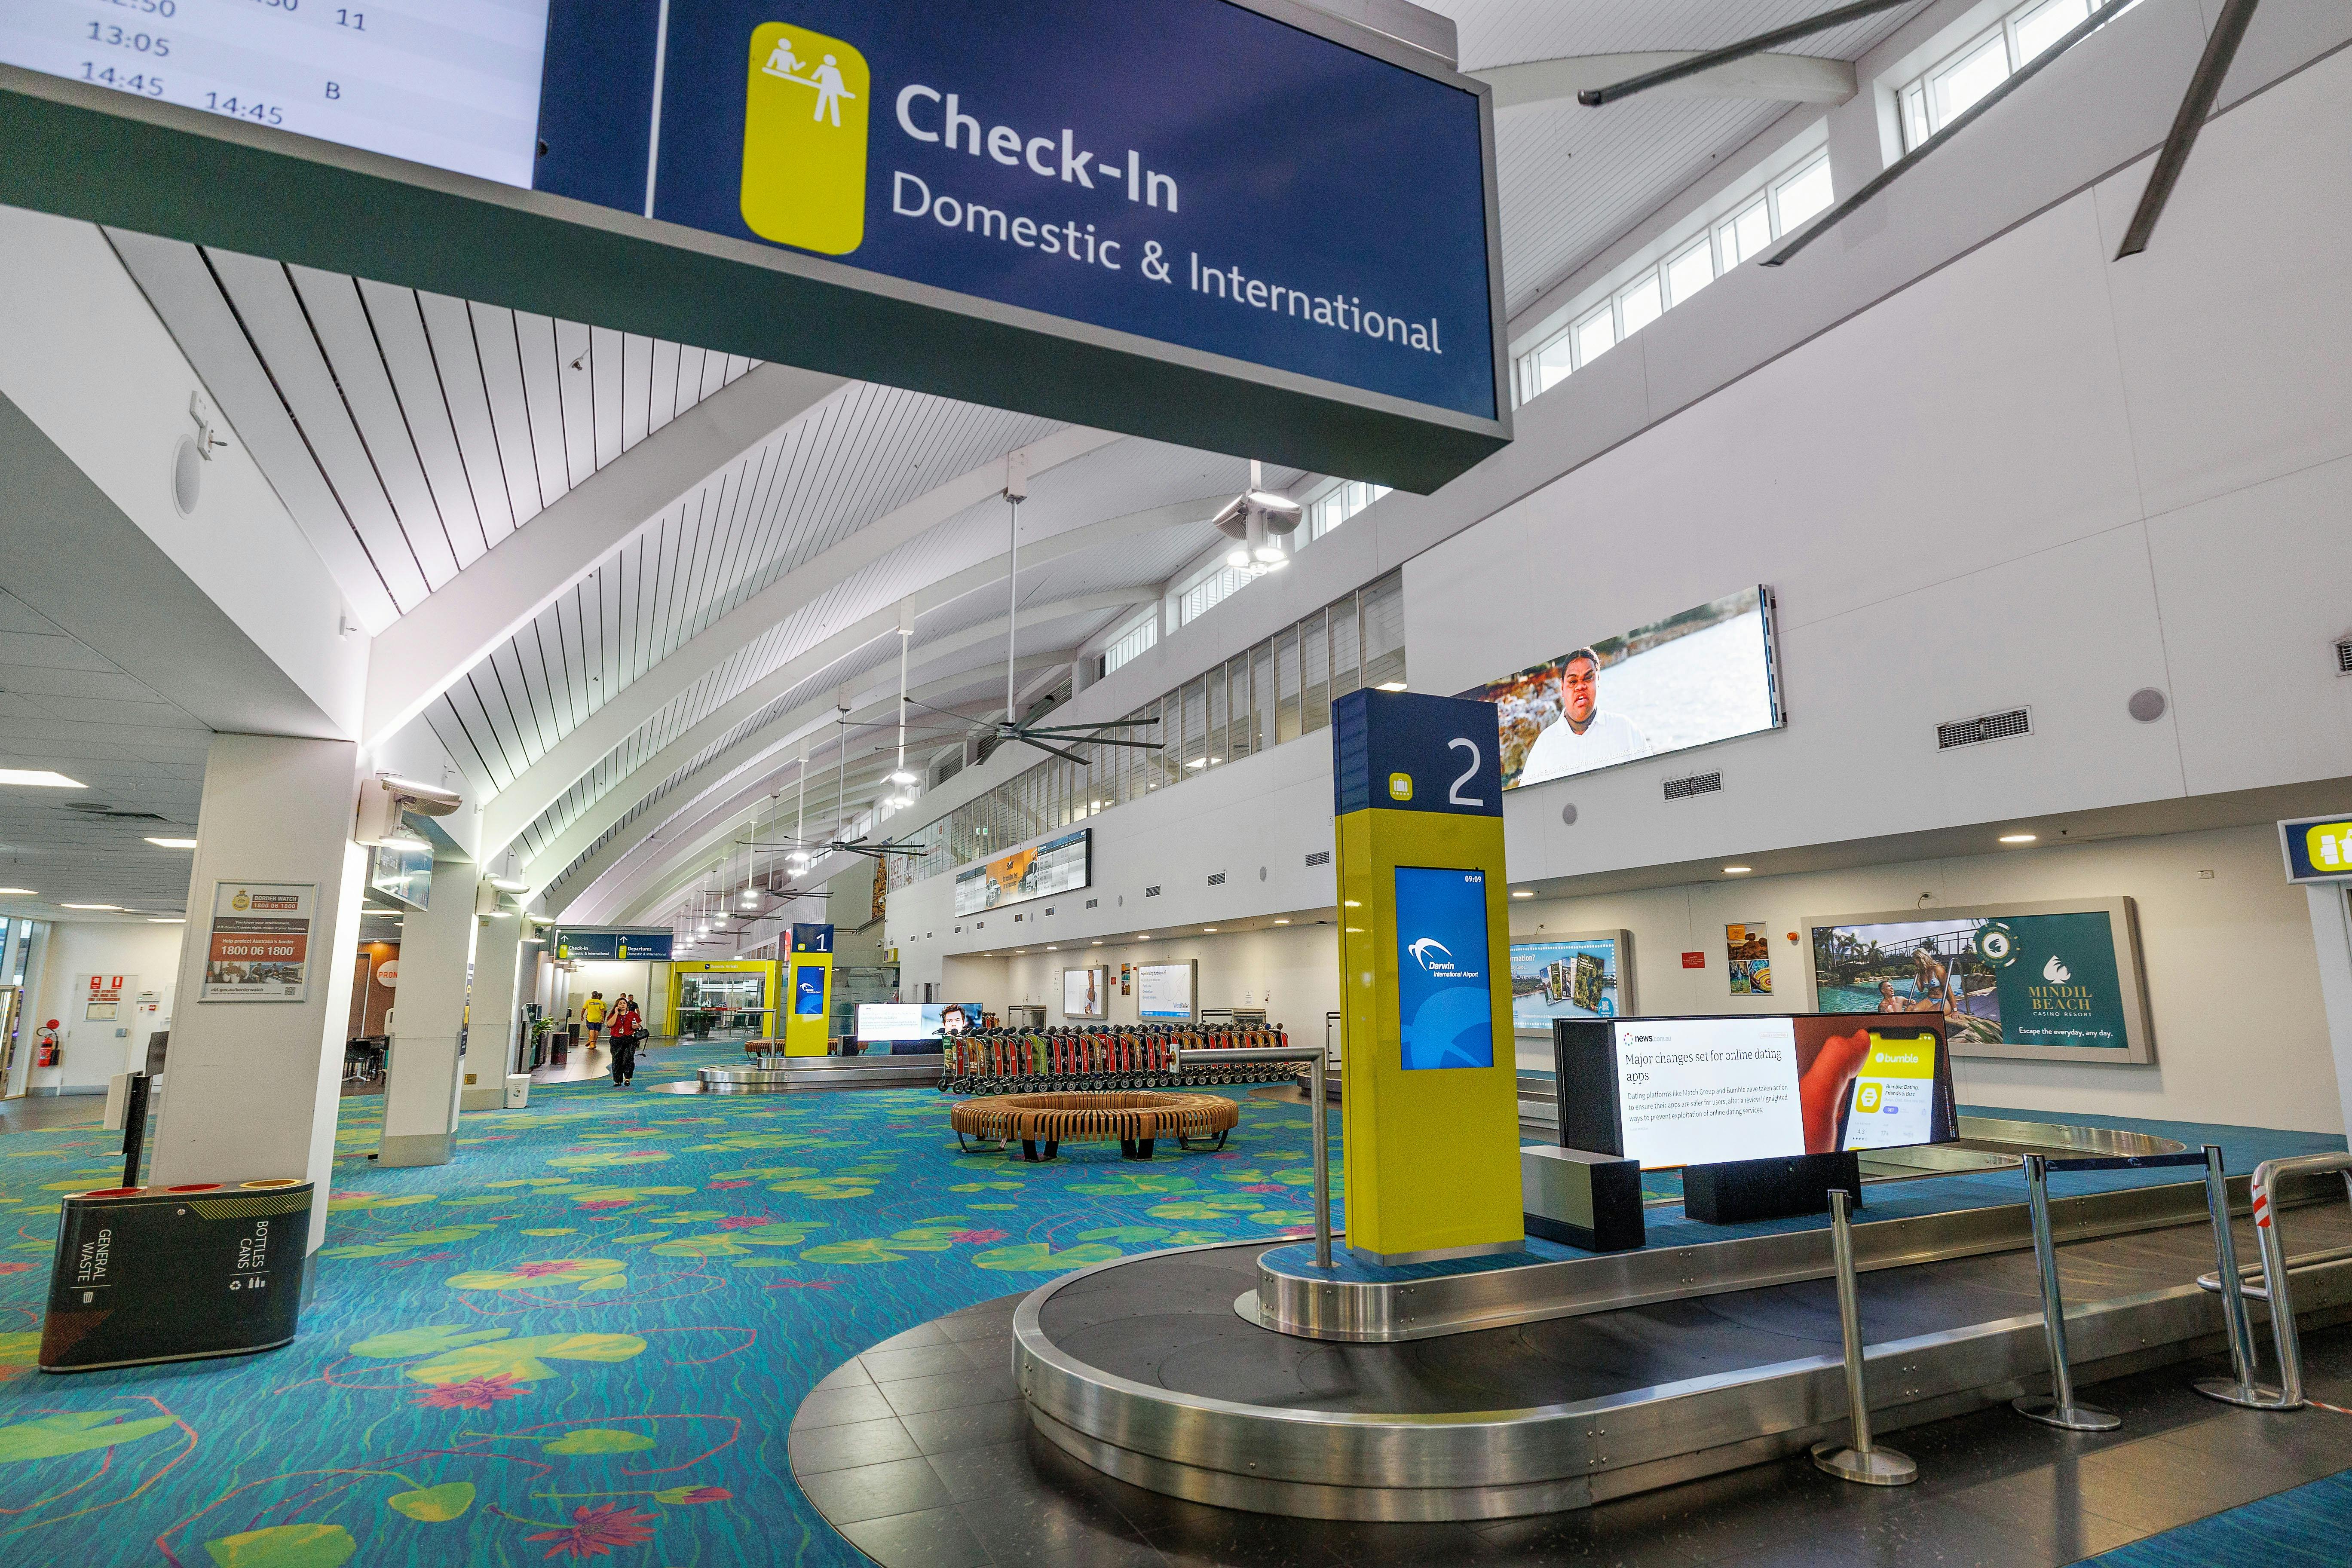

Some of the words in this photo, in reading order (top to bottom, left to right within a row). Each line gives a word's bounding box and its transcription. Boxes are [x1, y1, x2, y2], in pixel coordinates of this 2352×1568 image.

[336, 9, 366, 31] 11
[87, 21, 169, 57] 13:05
[82, 61, 164, 97] 14:45
[325, 80, 341, 100] B
[205, 92, 284, 125] 14:45
[895, 84, 1178, 213] Check-In
[893, 171, 1121, 270] Domestic
[1141, 240, 1172, 284] &
[1191, 251, 1442, 354] International
[1594, 754, 1608, 765] proud
[1448, 738, 1484, 806] 2
[1464, 875, 1482, 883] 09:09
[816, 934, 827, 951] 1
[221, 946, 248, 956] 1800
[250, 946, 264, 956] 06
[1510, 954, 1535, 962] rmation?
[1429, 962, 1455, 970] Darwin
[2027, 985, 2093, 999] MINDIL
[2032, 998, 2091, 1011] BEACH
[1635, 1034, 1672, 1043] news.com.au
[2018, 1026, 2040, 1037] Escape
[2041, 1027, 2052, 1035] the
[2053, 1029, 2084, 1040] everyday,
[2085, 1030, 2098, 1039] any
[2099, 1029, 2114, 1039] day.
[1625, 1054, 1653, 1068] Major
[1655, 1051, 1693, 1066] changes
[1695, 1051, 1708, 1063] set
[1710, 1050, 1724, 1062] for
[1725, 1049, 1753, 1060] online
[1755, 1047, 1782, 1061] dating
[1884, 1053, 1919, 1064] bumble
[1626, 1072, 1650, 1084] apps
[1646, 1091, 1672, 1099] platforms
[1700, 1089, 1715, 1097] Group
[1727, 1086, 1746, 1094] Bumble
[1761, 1094, 1788, 1103] highlighted
[1651, 1113, 1671, 1121] prevent
[1672, 1111, 1703, 1120] exploitation
[1726, 1108, 1742, 1116] dating
[252, 1221, 269, 1268] BOTTLES
[93, 1229, 112, 1280] GENERAL
[237, 1238, 252, 1269] CANS
[77, 1242, 95, 1282] WASTE
